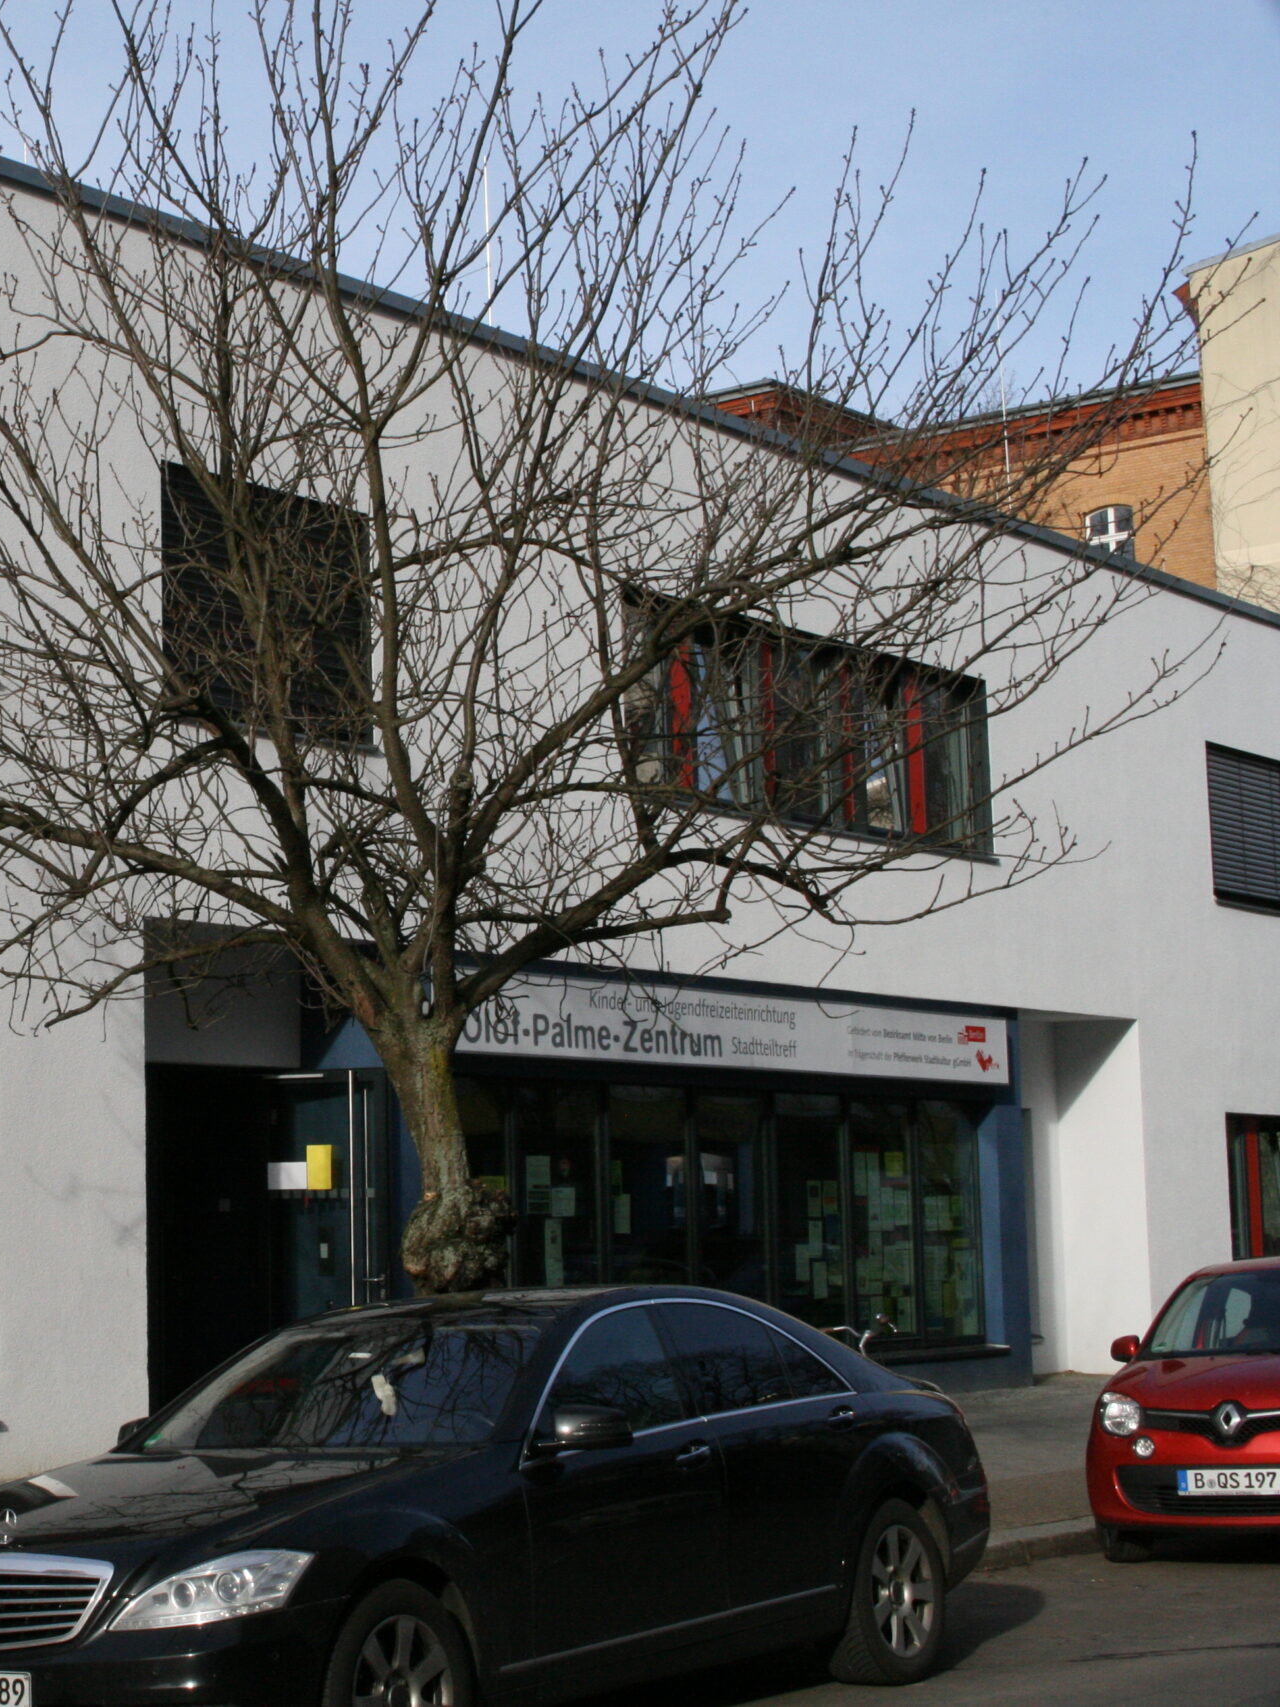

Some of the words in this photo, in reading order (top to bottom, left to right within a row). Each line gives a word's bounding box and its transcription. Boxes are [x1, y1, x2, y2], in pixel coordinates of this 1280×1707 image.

[662, 997, 796, 1030] Jugendfreizeiteinrichtung
[731, 1036, 797, 1058] Stadtteiltreff
[1194, 1472, 1206, 1489] B
[1217, 1472, 1241, 1489] QS
[1243, 1472, 1277, 1489] 197
